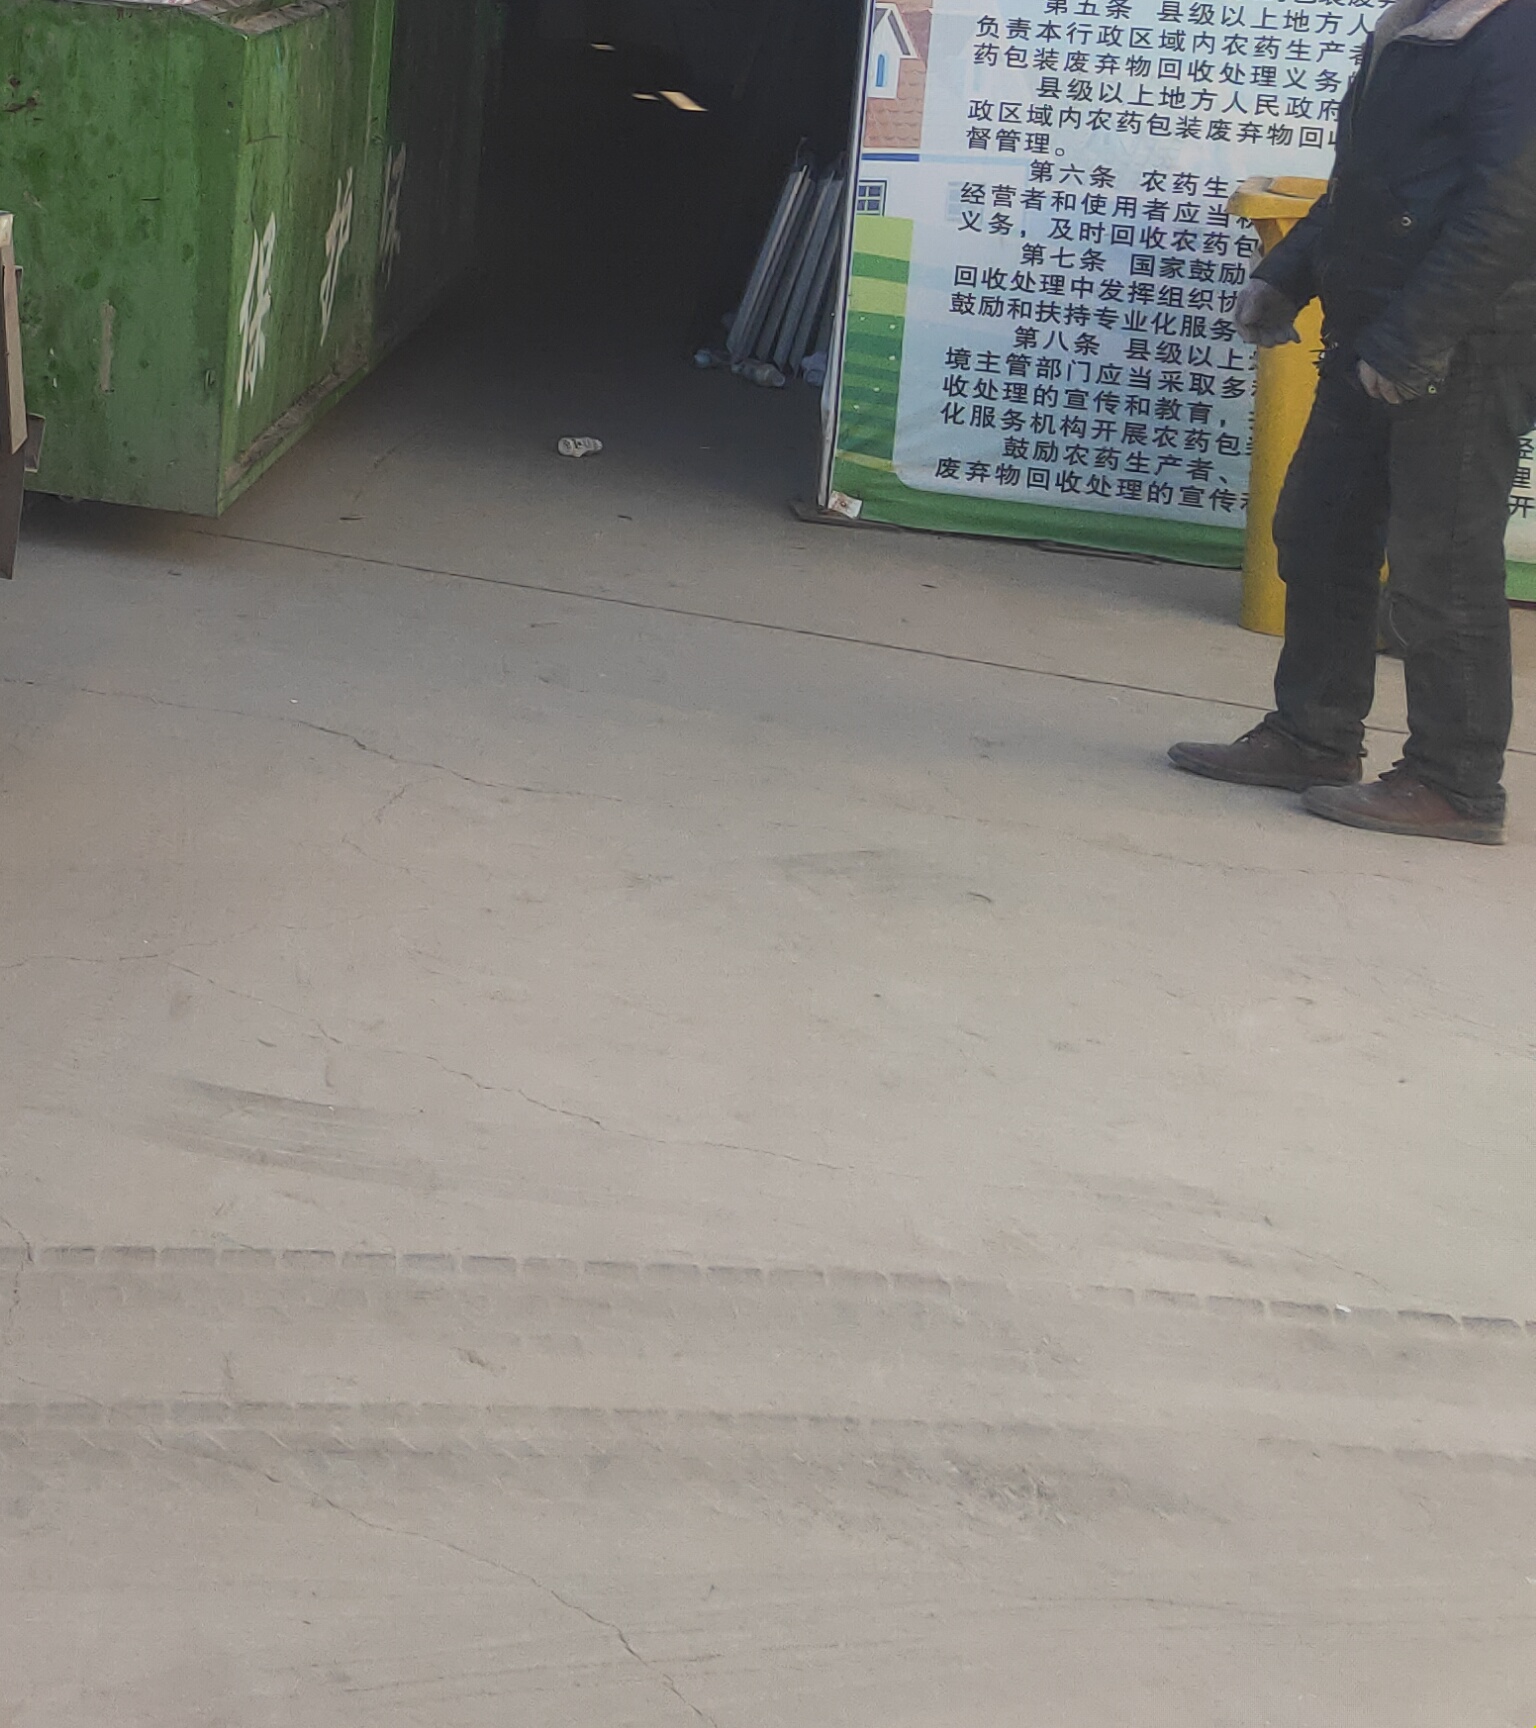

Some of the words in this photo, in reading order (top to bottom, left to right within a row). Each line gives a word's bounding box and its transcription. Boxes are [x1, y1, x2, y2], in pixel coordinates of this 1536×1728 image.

[973, 44, 1358, 94] 药包装废弃物回收处理义务
[966, 127, 1066, 158] 督管理。
[1141, 170, 1246, 199] 农药生
[950, 293, 1236, 342] 鼓励和扶持专业化服务
[945, 346, 1257, 400] 境主管部门应当采取多
[943, 375, 1256, 431] 收处理的宣传和教育，
[1002, 437, 1232, 484] 鼓励农药生产者、
